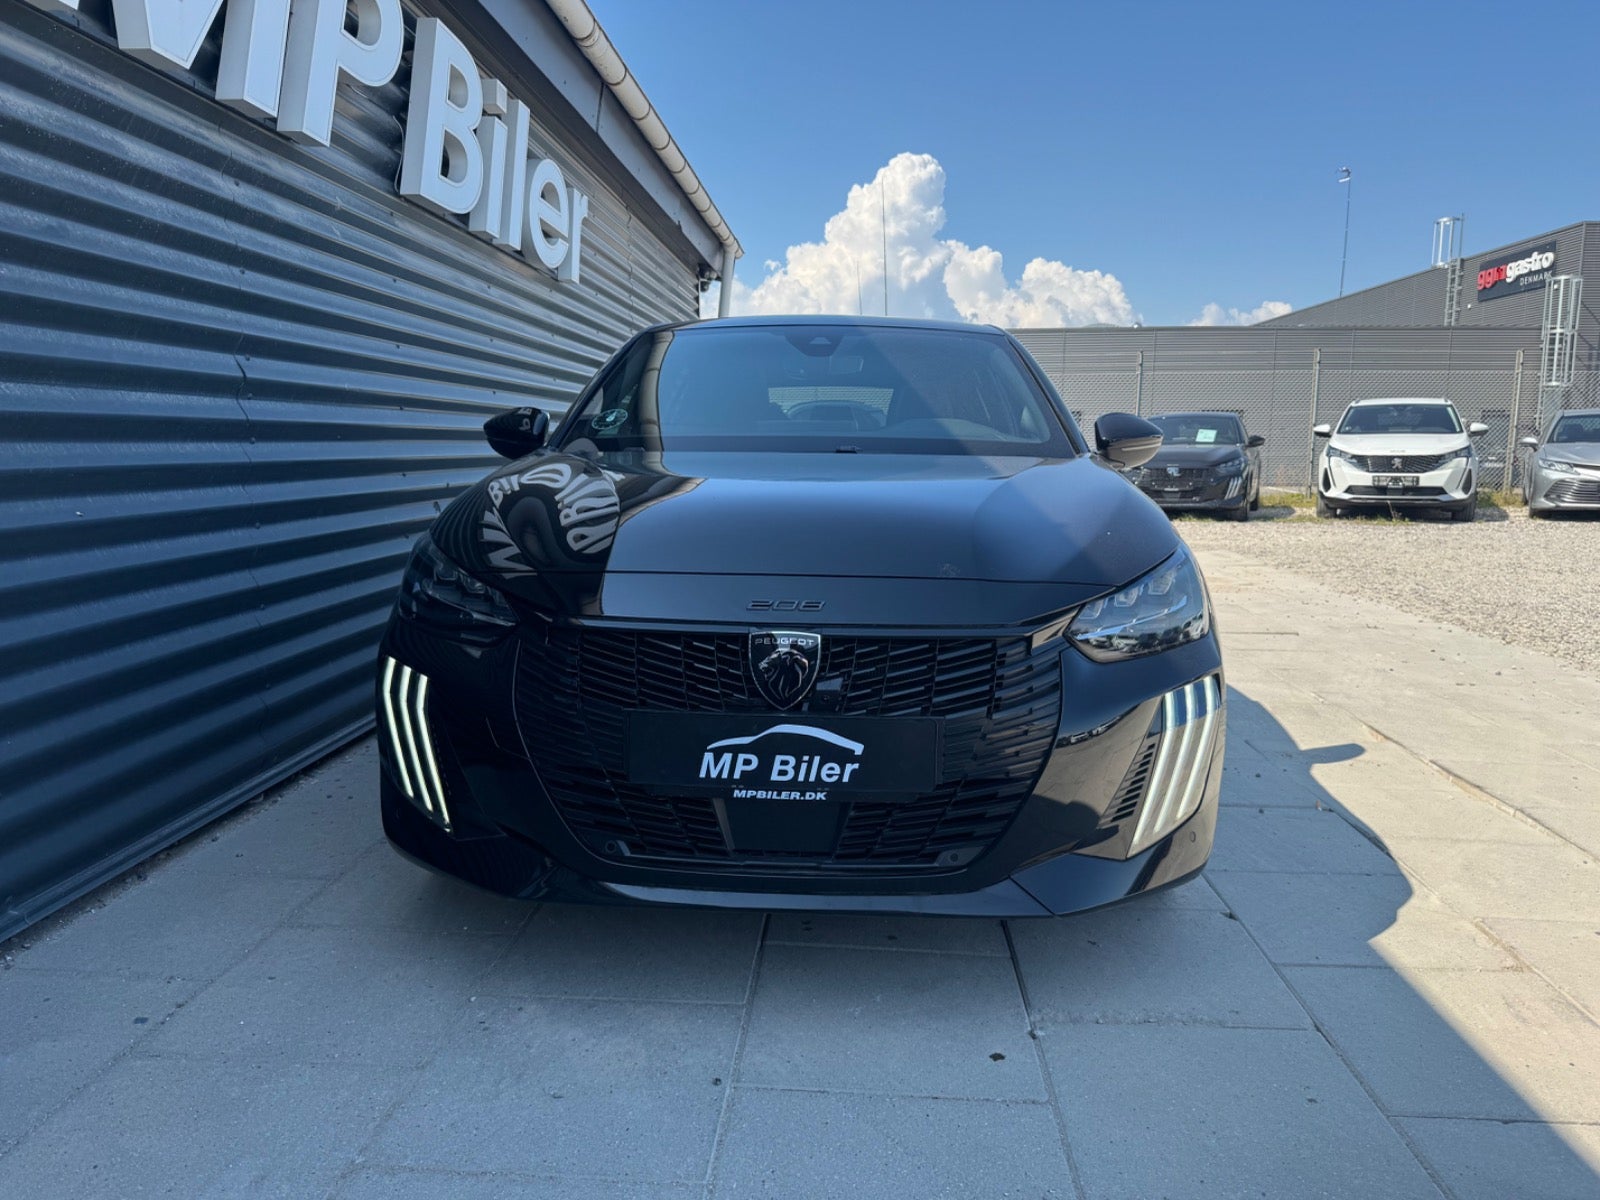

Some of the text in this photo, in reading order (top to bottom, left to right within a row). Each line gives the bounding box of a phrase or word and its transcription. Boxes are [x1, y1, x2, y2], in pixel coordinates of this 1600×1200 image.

[401, 17, 588, 283] Biler
[746, 600, 825, 612] 208
[754, 637, 815, 646] PEUGEOT
[699, 752, 860, 783] MP Biler
[733, 789, 828, 801] MPBILER.DK
